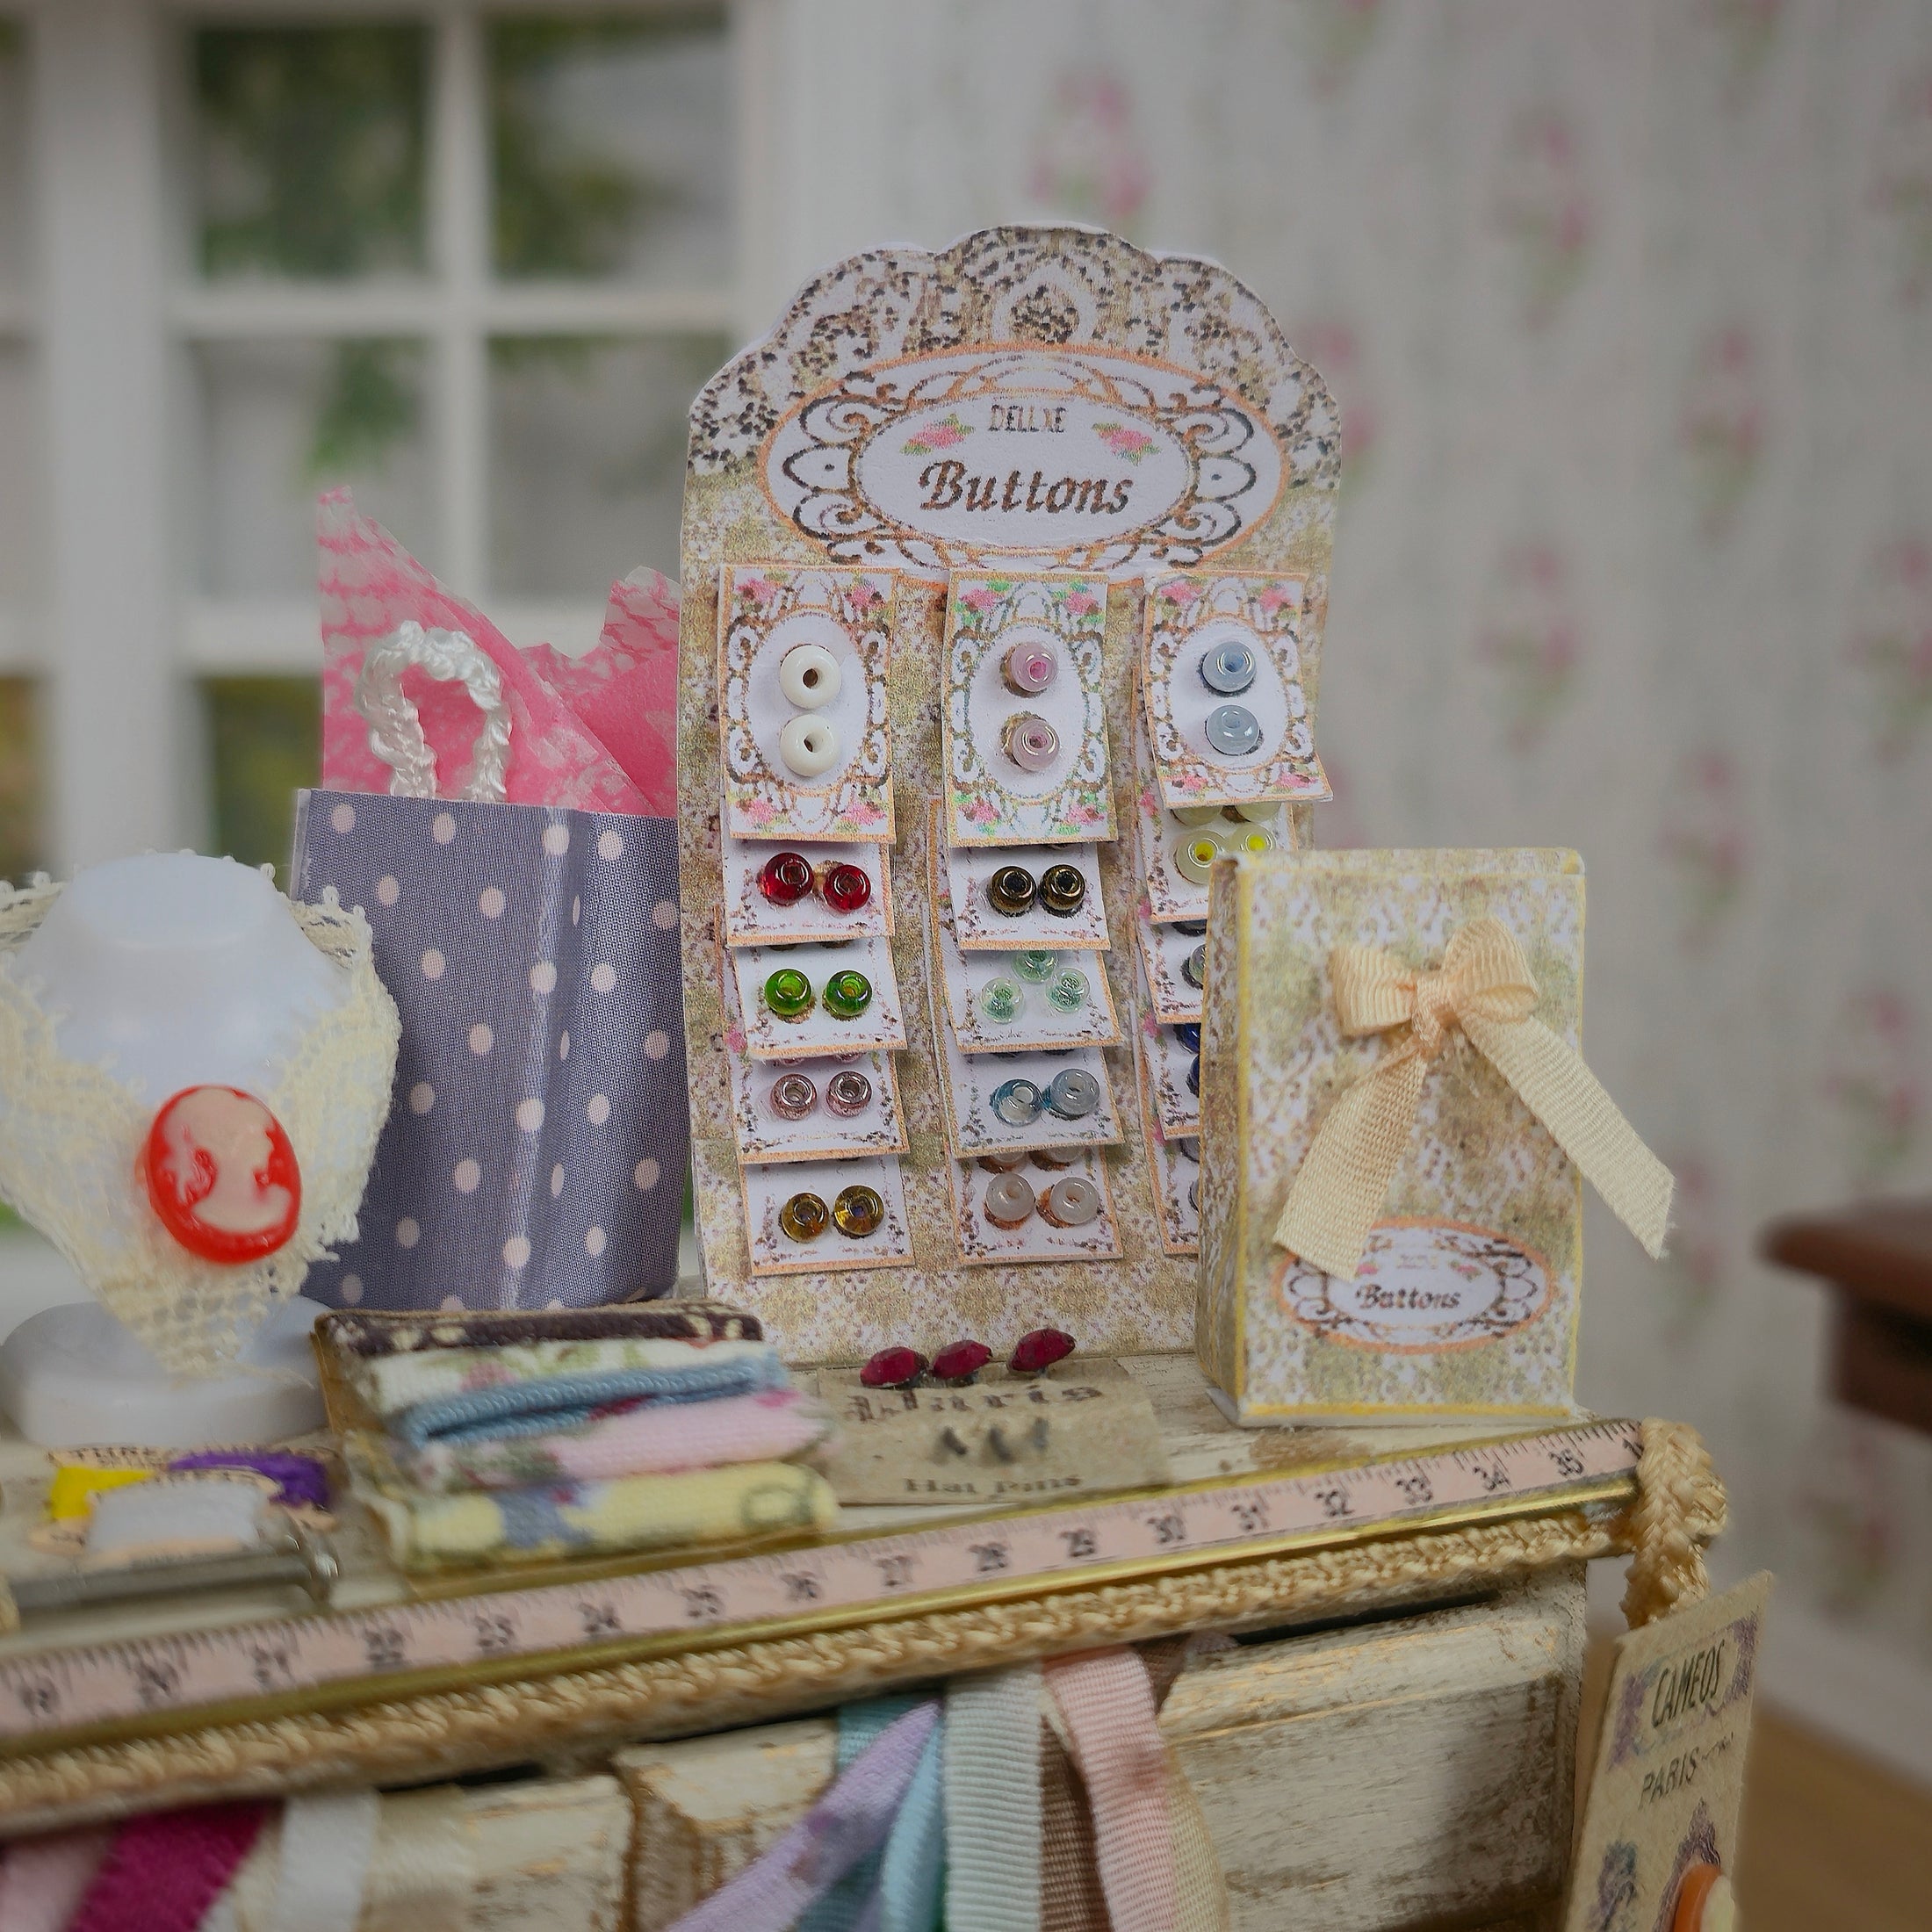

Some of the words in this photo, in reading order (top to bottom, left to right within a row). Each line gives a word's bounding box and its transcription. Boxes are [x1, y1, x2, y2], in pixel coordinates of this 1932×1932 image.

[919, 458, 1133, 515] Buttons
[1356, 1284, 1461, 1309] Buttons
[1148, 1515, 1186, 1543] 30
[1316, 1489, 1355, 1517] 32
[1397, 1476, 1433, 1504] 33
[1474, 1464, 1511, 1491] 34
[1549, 1449, 1584, 1476] 35
[1650, 1638, 1726, 1730] CAMEOS
[1637, 1745, 1700, 1812] PARIS
